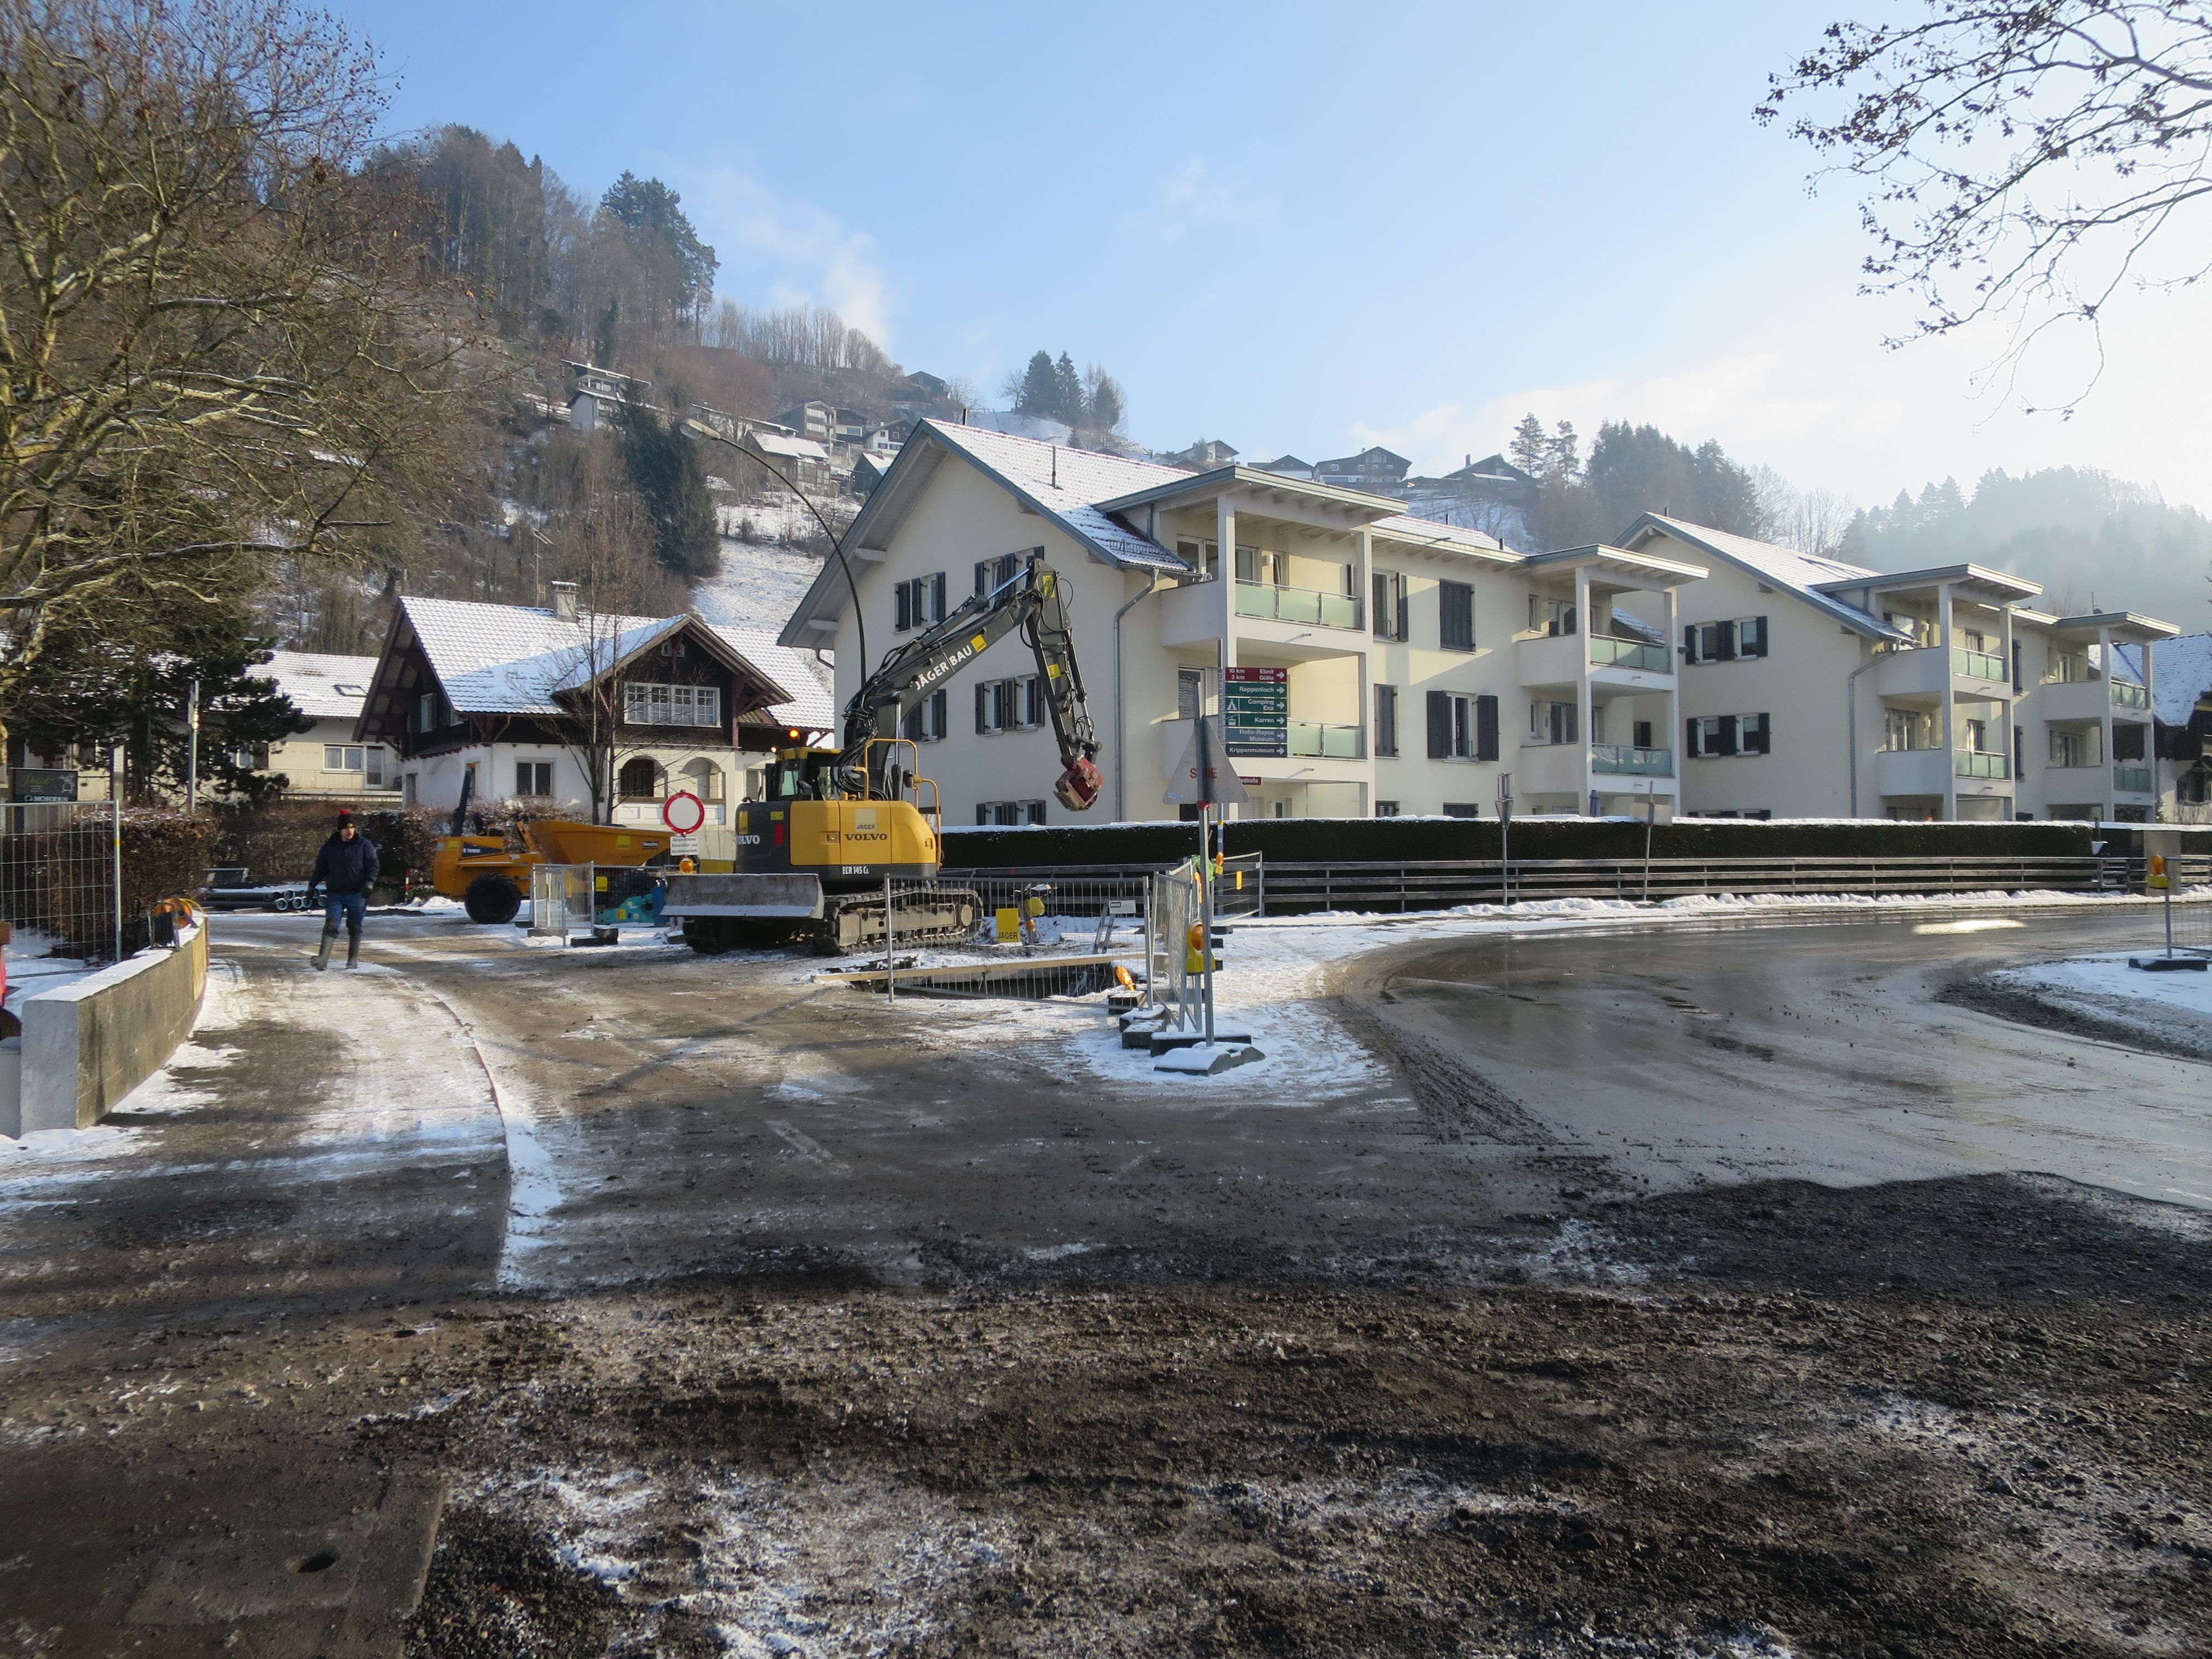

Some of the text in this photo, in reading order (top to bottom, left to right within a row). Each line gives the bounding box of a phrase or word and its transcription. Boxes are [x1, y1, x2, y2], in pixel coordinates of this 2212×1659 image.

[915, 645, 972, 691] JÄGER BAU
[853, 866, 863, 874] 145
